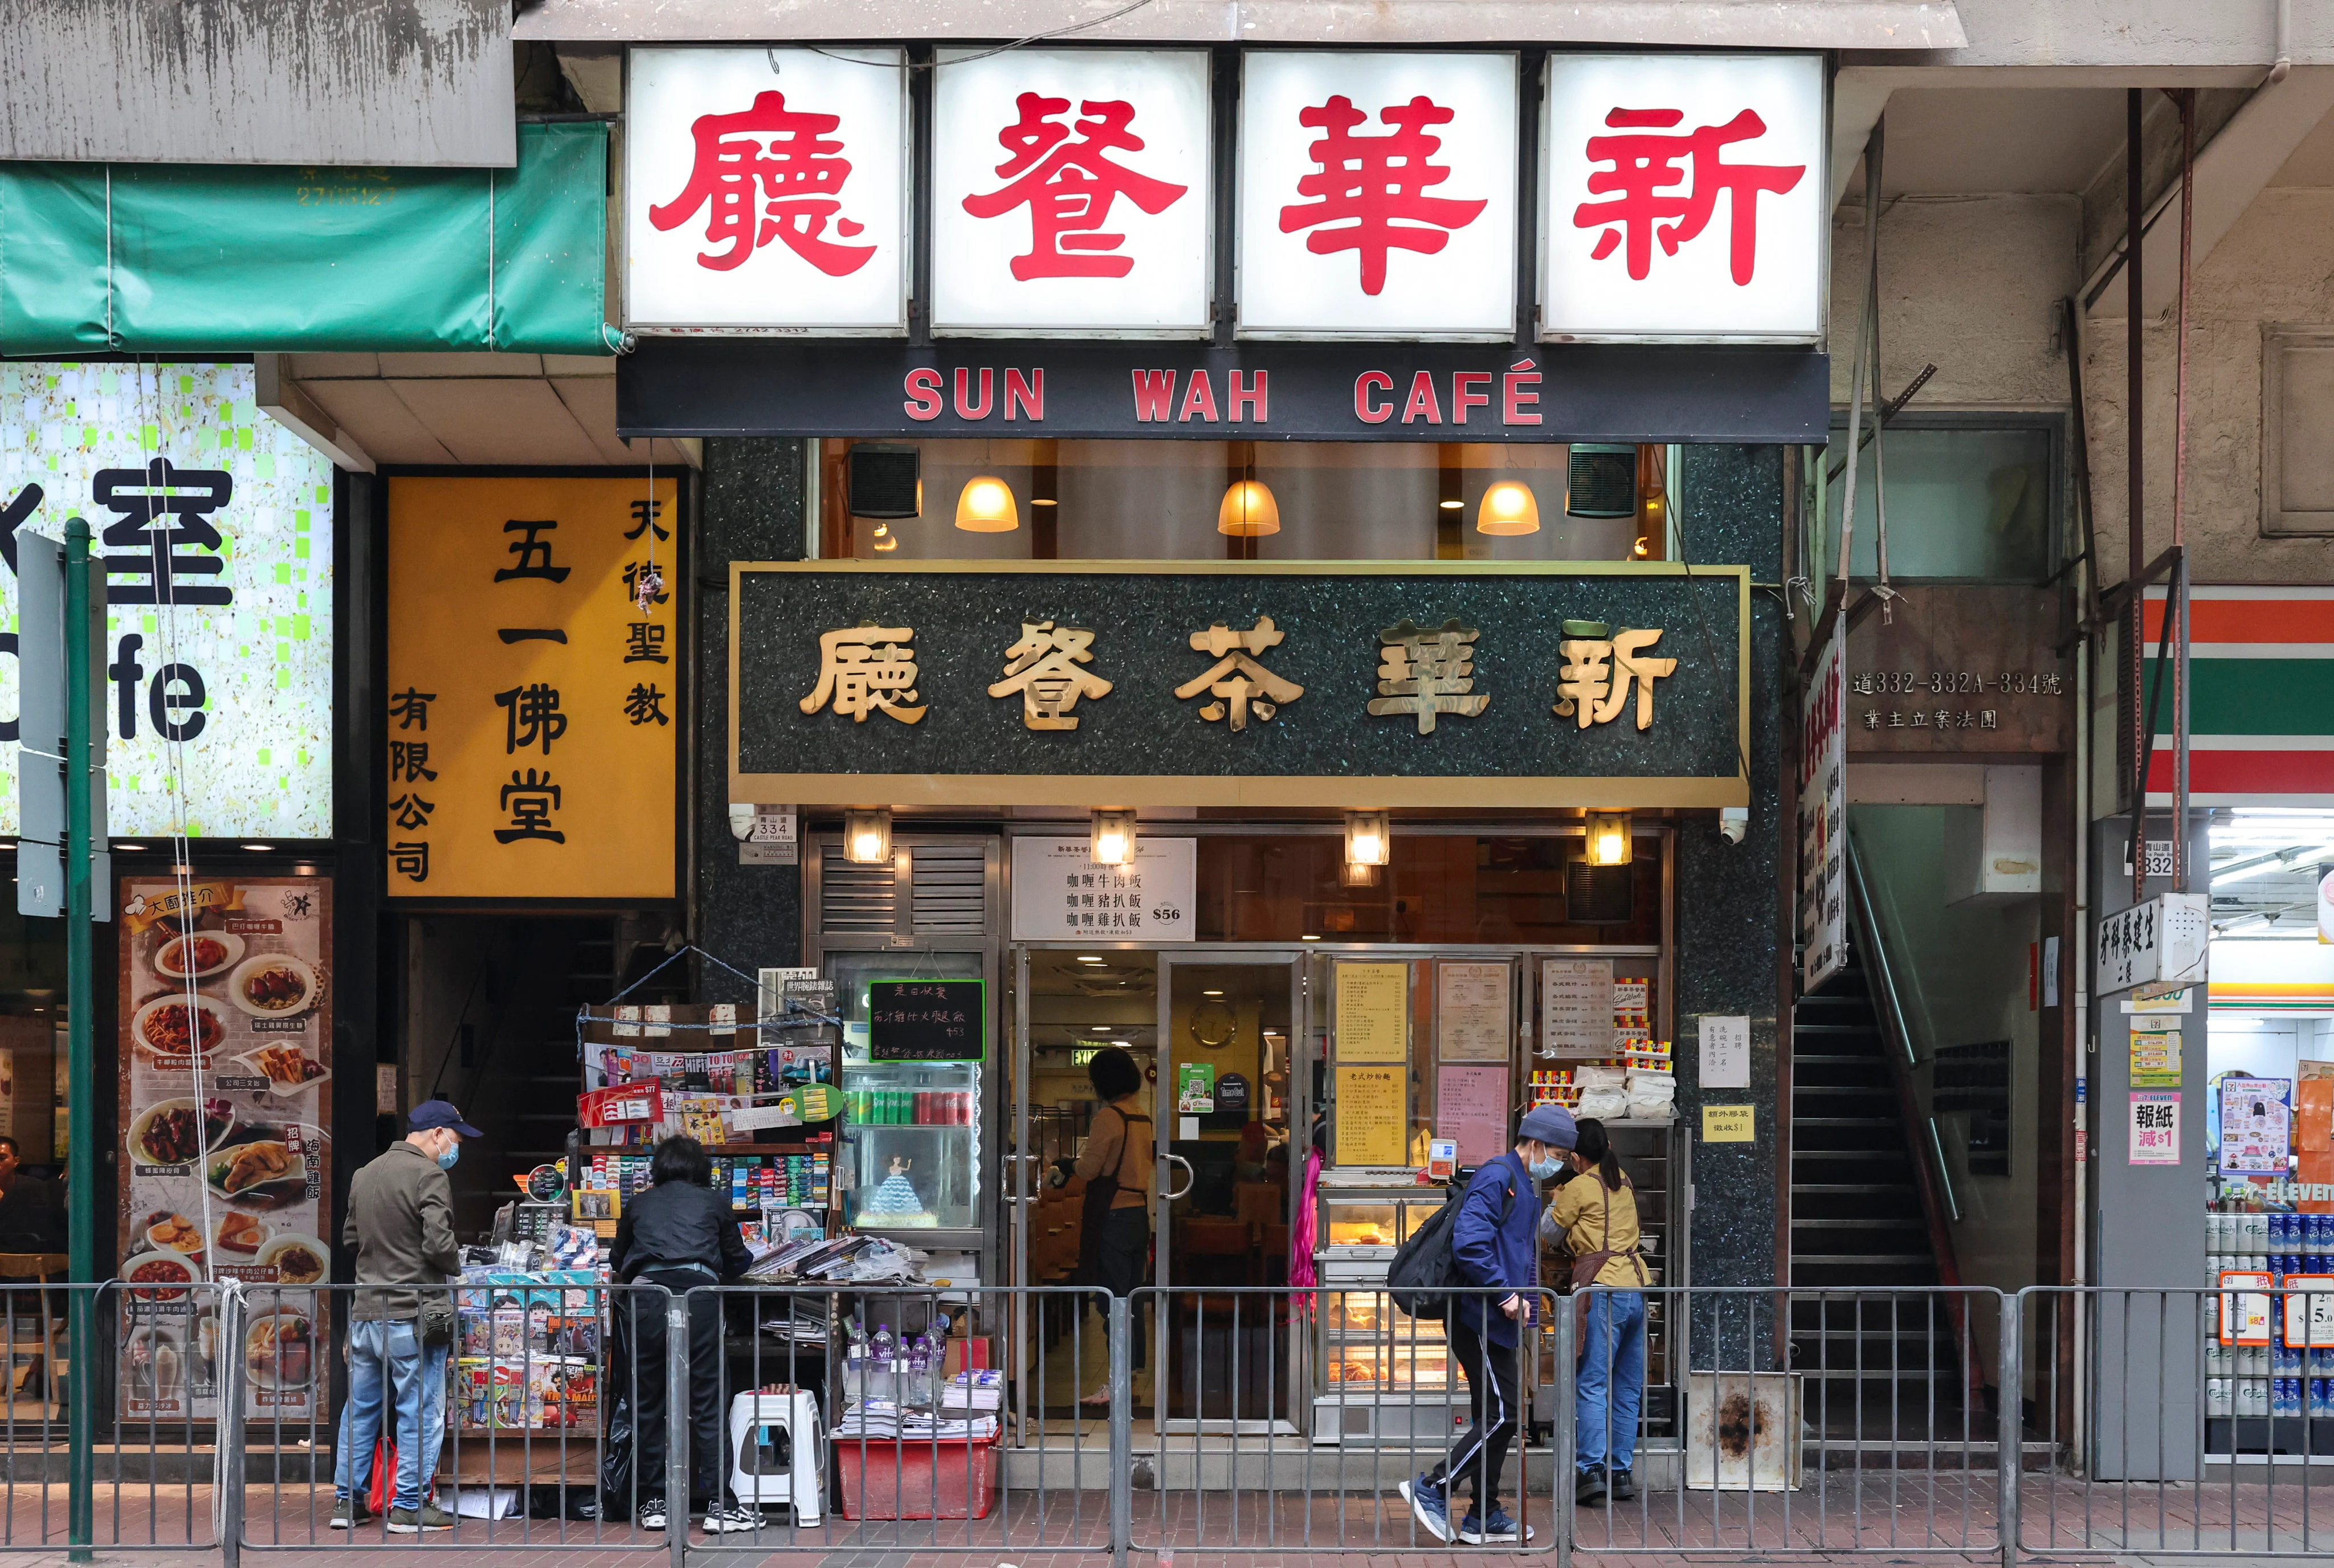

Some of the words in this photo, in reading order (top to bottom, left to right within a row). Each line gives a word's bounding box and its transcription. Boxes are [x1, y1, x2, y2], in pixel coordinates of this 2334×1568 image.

[904, 367, 1045, 423] SUN
[1132, 369, 1269, 425] WAH
[1354, 358, 1543, 427] CAFÉ
[493, 519, 571, 845] 五一佛堂
[1864, 709, 1997, 729] 業主立案法團
[387, 687, 438, 883] 有限公司
[760, 824, 786, 834] 334
[1067, 873, 1141, 888] 咖喱牛肉飯
[1067, 893, 1141, 908] 咖喱豬扒飯
[1067, 912, 1141, 928] 咖喱雞扒飯
[1153, 909, 1181, 920] $56
[787, 981, 834, 991] 世界腕錶雜誌
[1734, 1034, 1742, 1050] 招聘
[2136, 1104, 2173, 1129] 報紙
[287, 1127, 300, 1152] 招牌
[306, 1139, 321, 1199] 海南雞飯
[2257, 1276, 2268, 1287] 抵
[2289, 1279, 2298, 1289] 抵
[912, 1357, 926, 1368] vita
